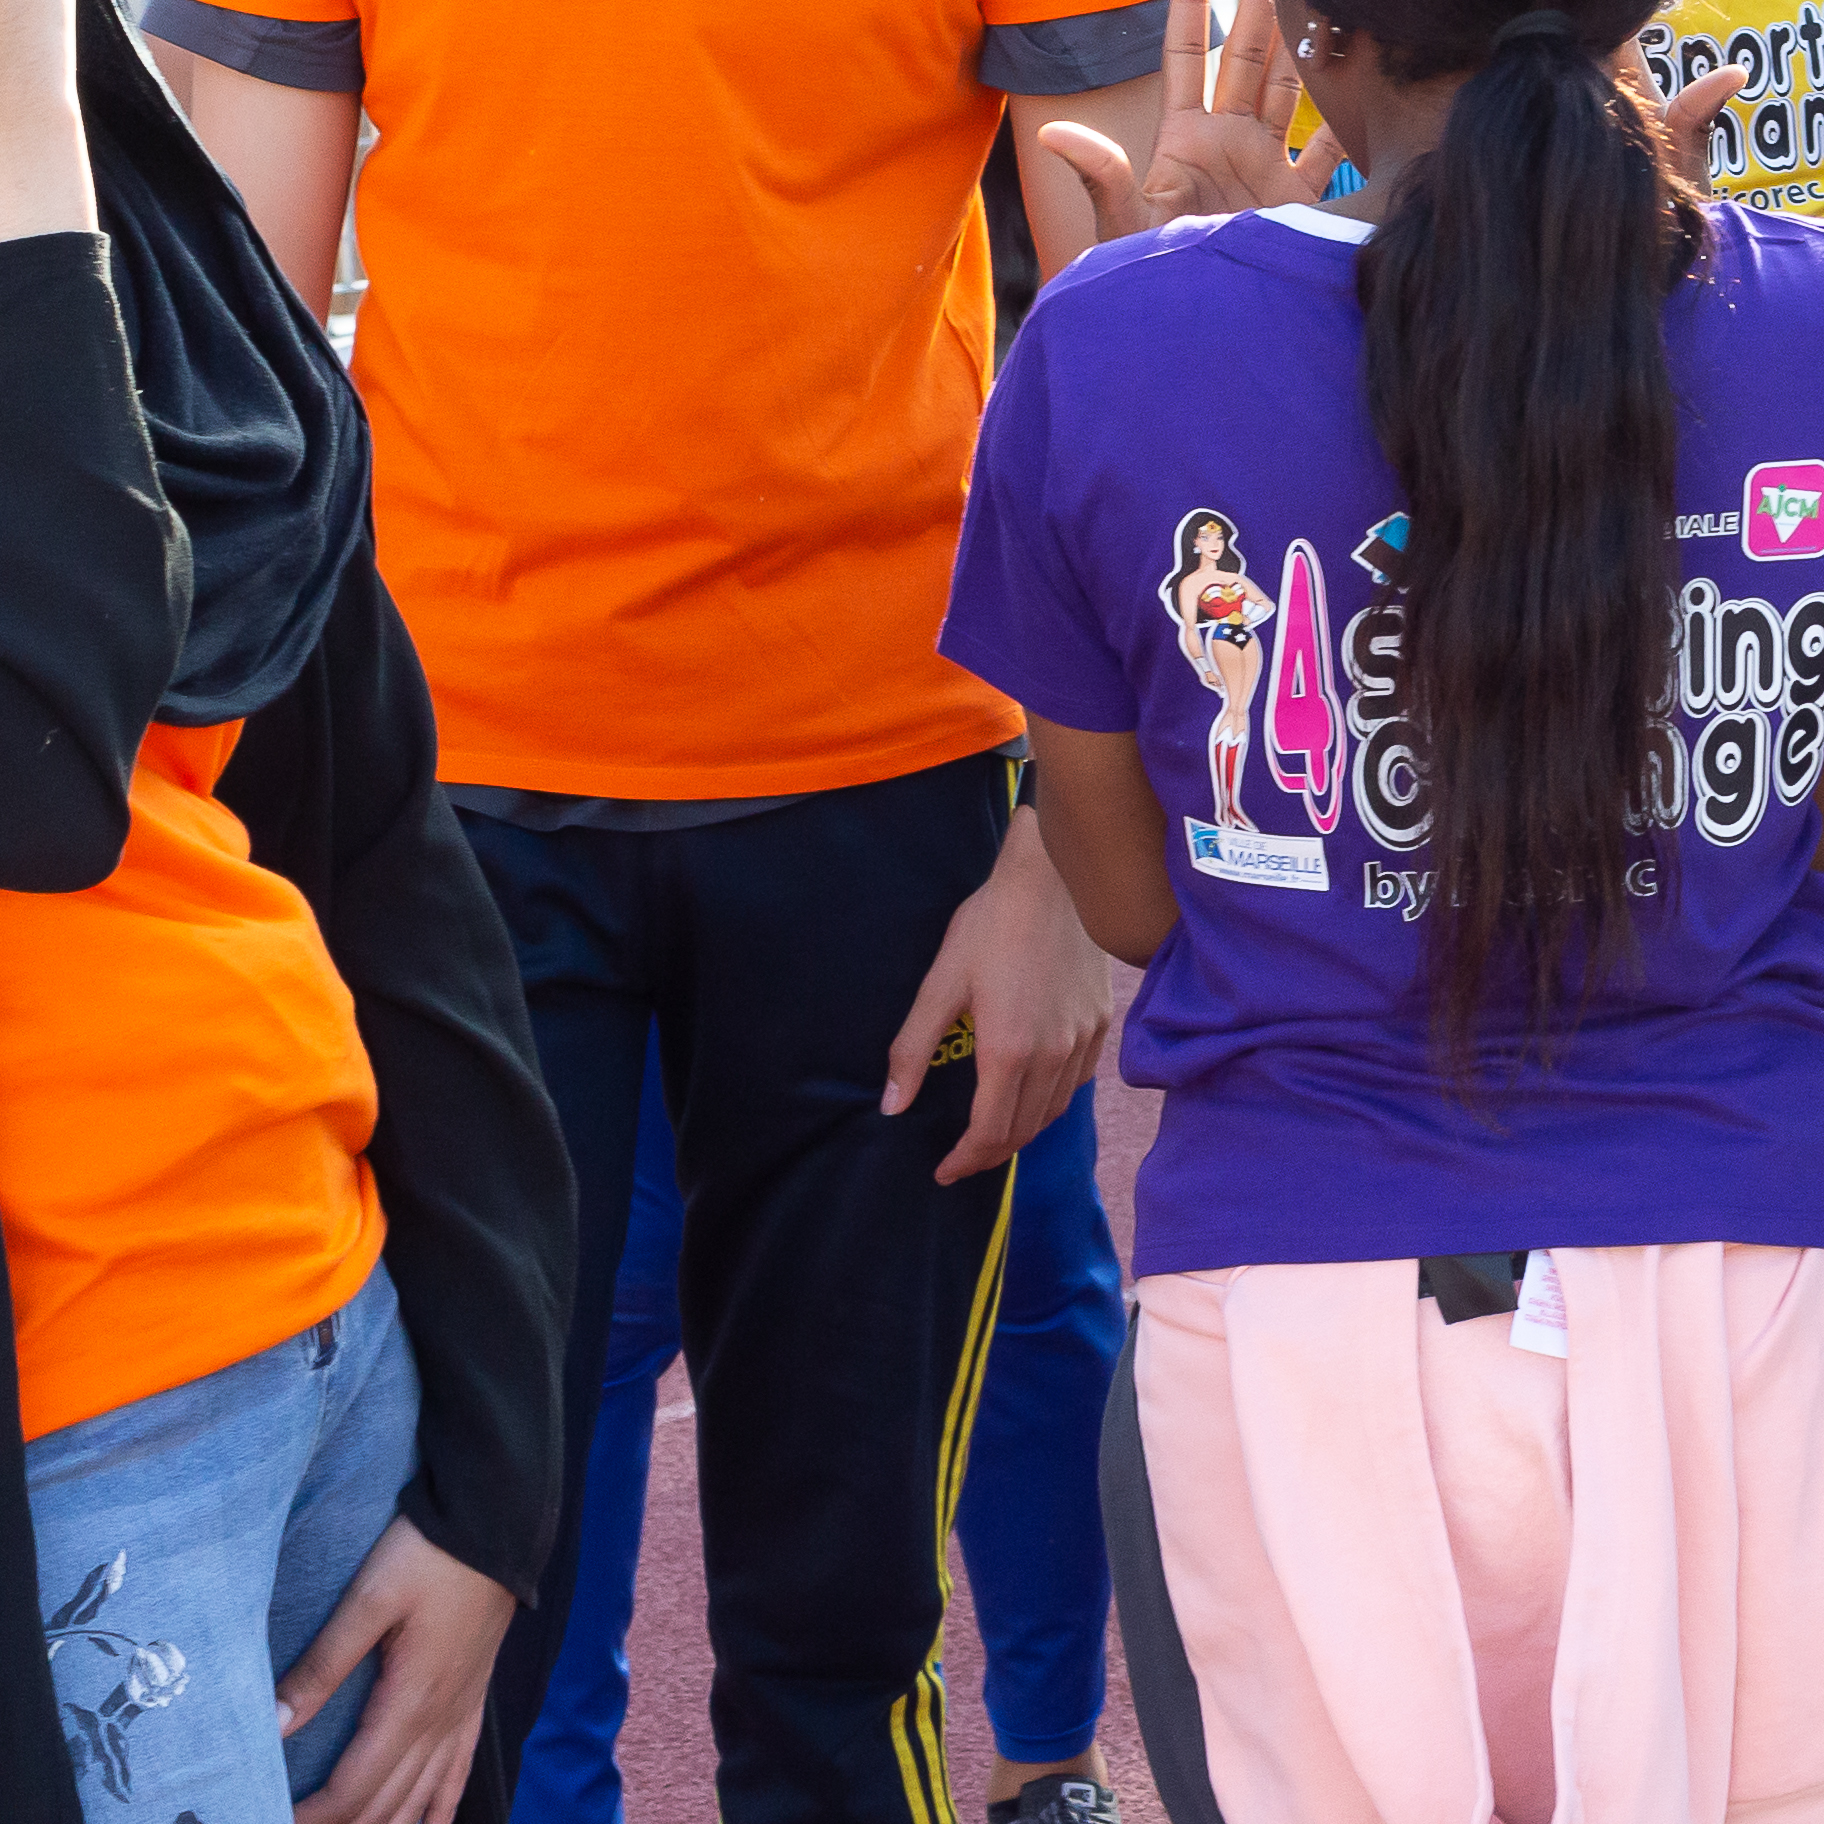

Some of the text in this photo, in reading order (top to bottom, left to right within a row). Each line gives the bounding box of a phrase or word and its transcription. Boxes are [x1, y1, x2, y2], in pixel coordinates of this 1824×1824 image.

[1264, 537, 1346, 834] 4
[1228, 849, 1322, 874] MARSEILLE
[1364, 860, 1439, 922] by
